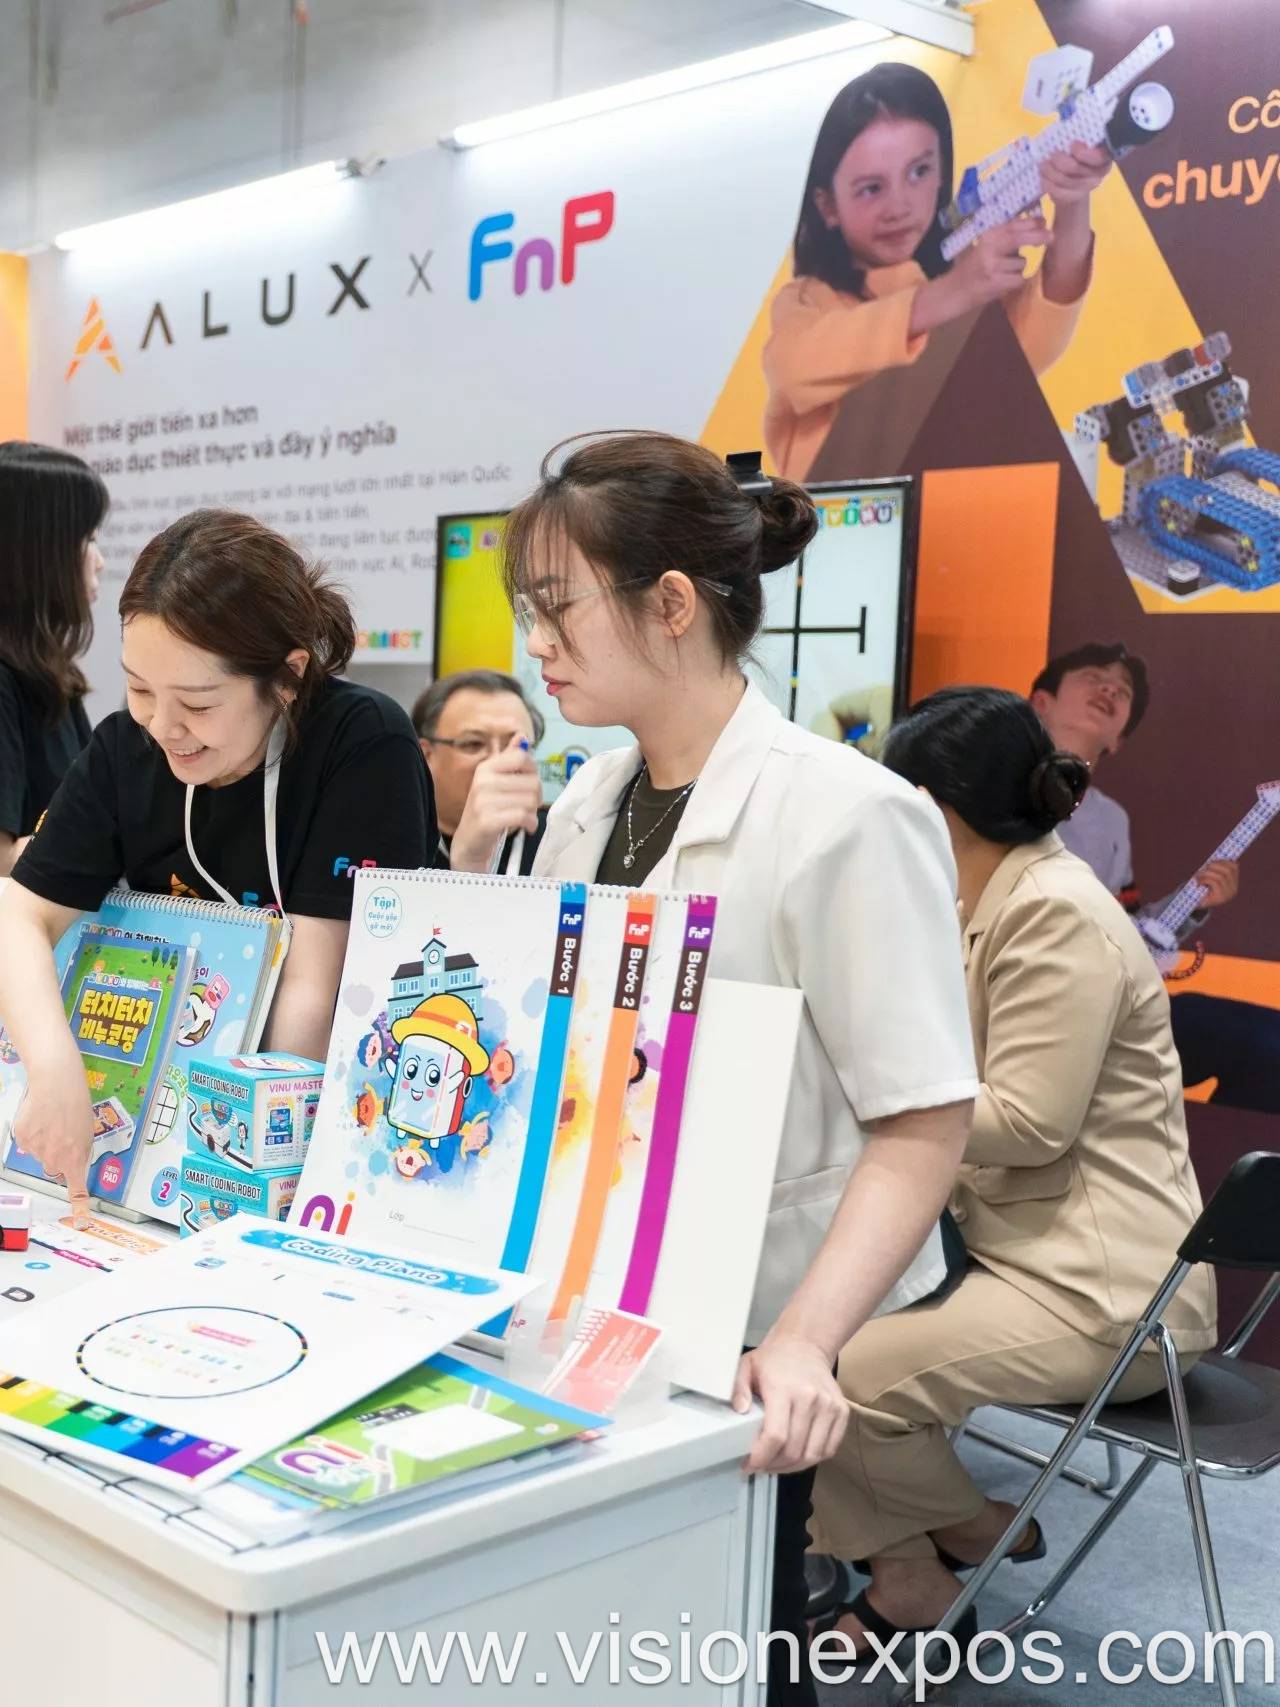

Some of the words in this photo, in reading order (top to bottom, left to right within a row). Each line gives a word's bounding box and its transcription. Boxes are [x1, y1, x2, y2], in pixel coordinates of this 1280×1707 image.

[1143, 155, 1280, 208] chuy
[140, 255, 372, 350] ALUX
[468, 190, 615, 302] FnP
[222, 406, 258, 426] hơn
[252, 435, 275, 458] và
[279, 429, 314, 458] đầy
[337, 421, 397, 456] nghĩa
[355, 628, 423, 652] ONNECT
[562, 913, 582, 926] FnP
[628, 924, 649, 937] FnP
[688, 926, 711, 939] FnP
[560, 937, 577, 982] Bước
[624, 948, 643, 993] Bước
[682, 951, 702, 997] Bước
[80, 989, 154, 1025] 터치터치
[622, 996, 635, 1007] 2
[679, 1001, 694, 1011] 3
[78, 1017, 139, 1054] 비누코딩
[191, 1072, 209, 1087] SMART
[210, 1078, 230, 1094] CODING
[231, 1083, 249, 1099] ROBOT
[269, 1082, 291, 1093] VINU
[293, 1080, 324, 1091] MASTE
[102, 1171, 118, 1184] PAD
[162, 1170, 178, 1181] LEVEL
[185, 1170, 209, 1186] SMART
[211, 1176, 236, 1193] CODING
[238, 1183, 261, 1199] ROBOT
[159, 1182, 171, 1199] 2
[287, 1241, 365, 1266] Coding
[372, 1258, 443, 1282] Piano
